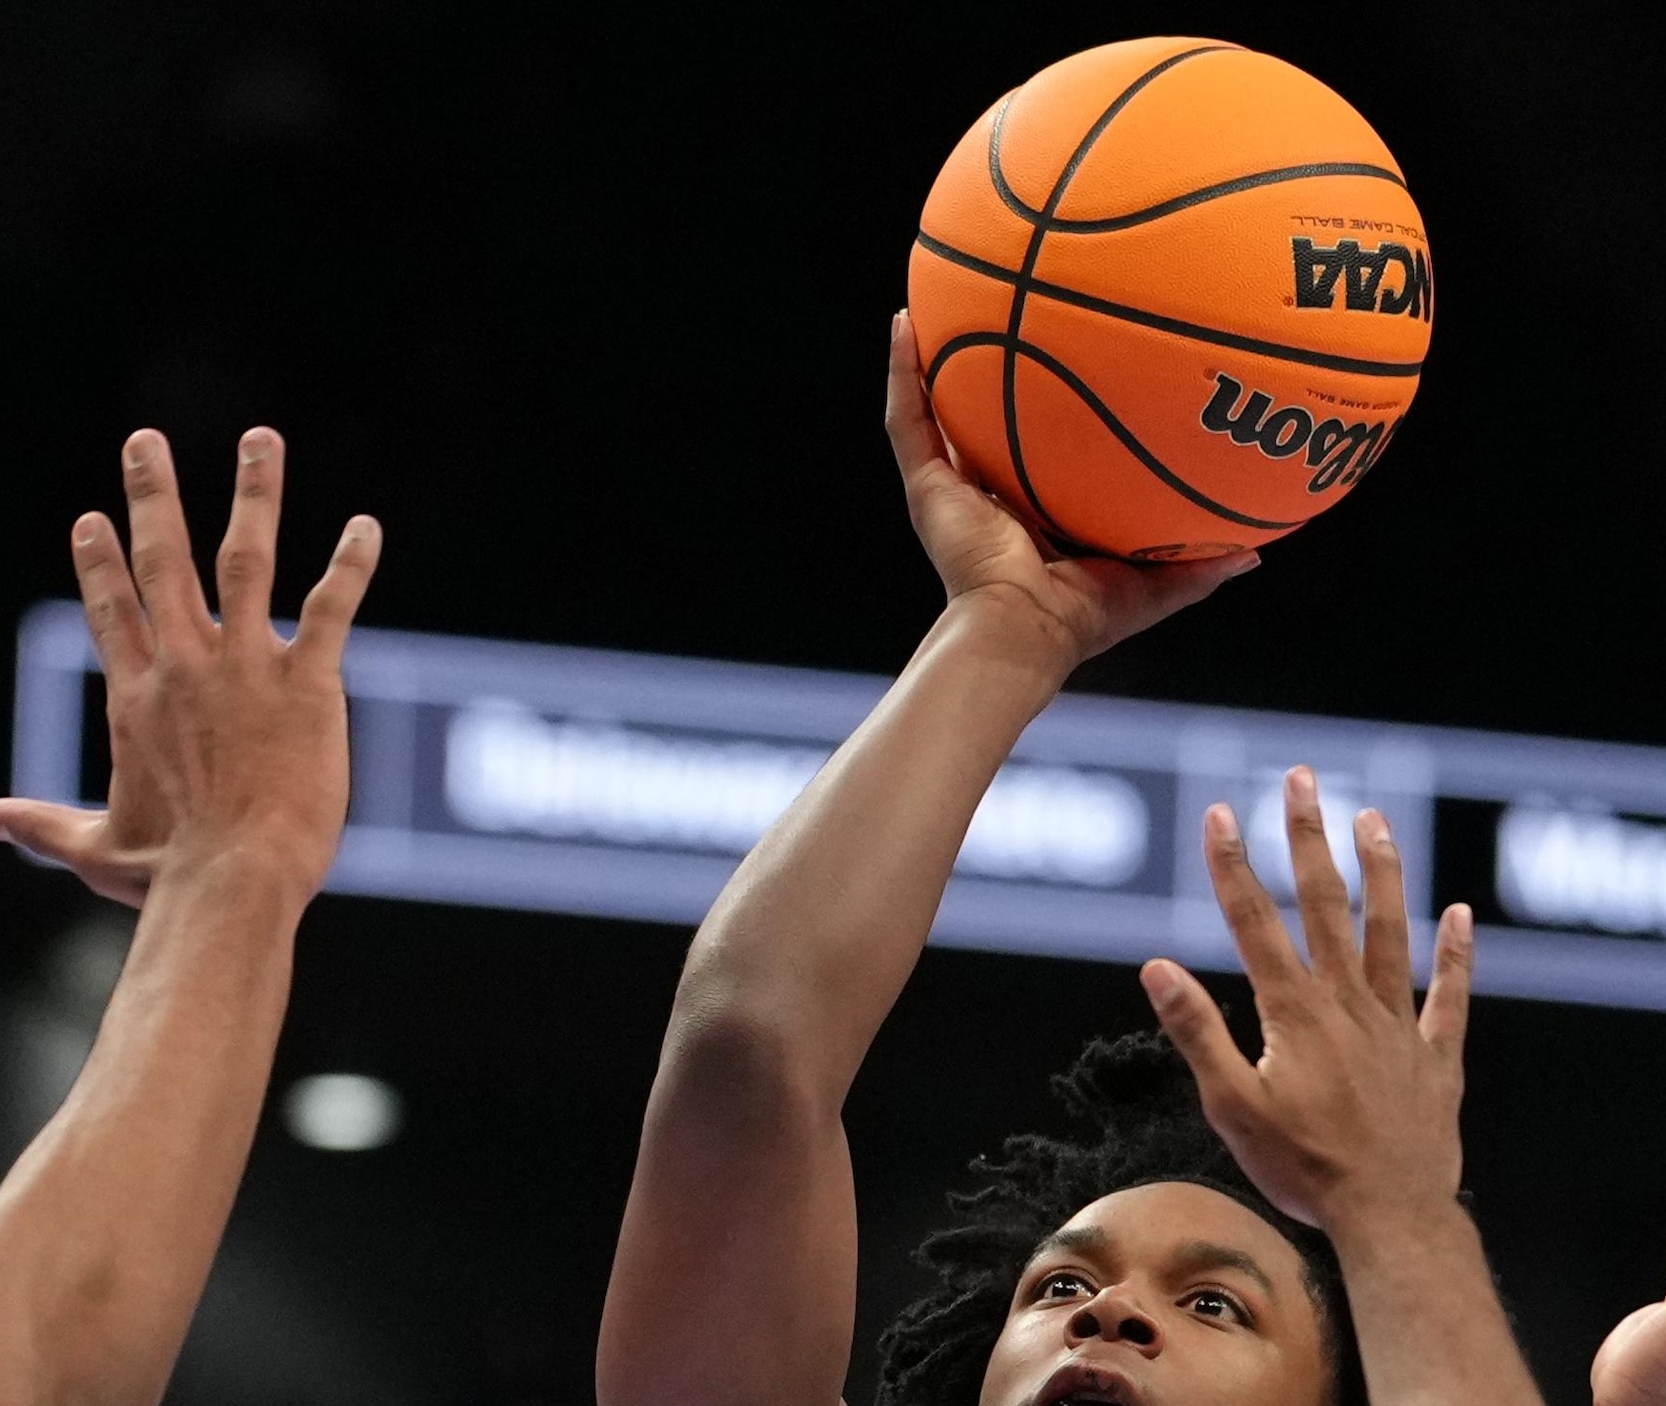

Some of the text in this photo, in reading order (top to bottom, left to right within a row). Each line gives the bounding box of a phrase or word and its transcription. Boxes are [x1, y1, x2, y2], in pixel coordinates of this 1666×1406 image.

[1290, 216, 1344, 229] BALL
[1291, 236, 1431, 324] NCAA
[1199, 371, 1406, 495] ilson
